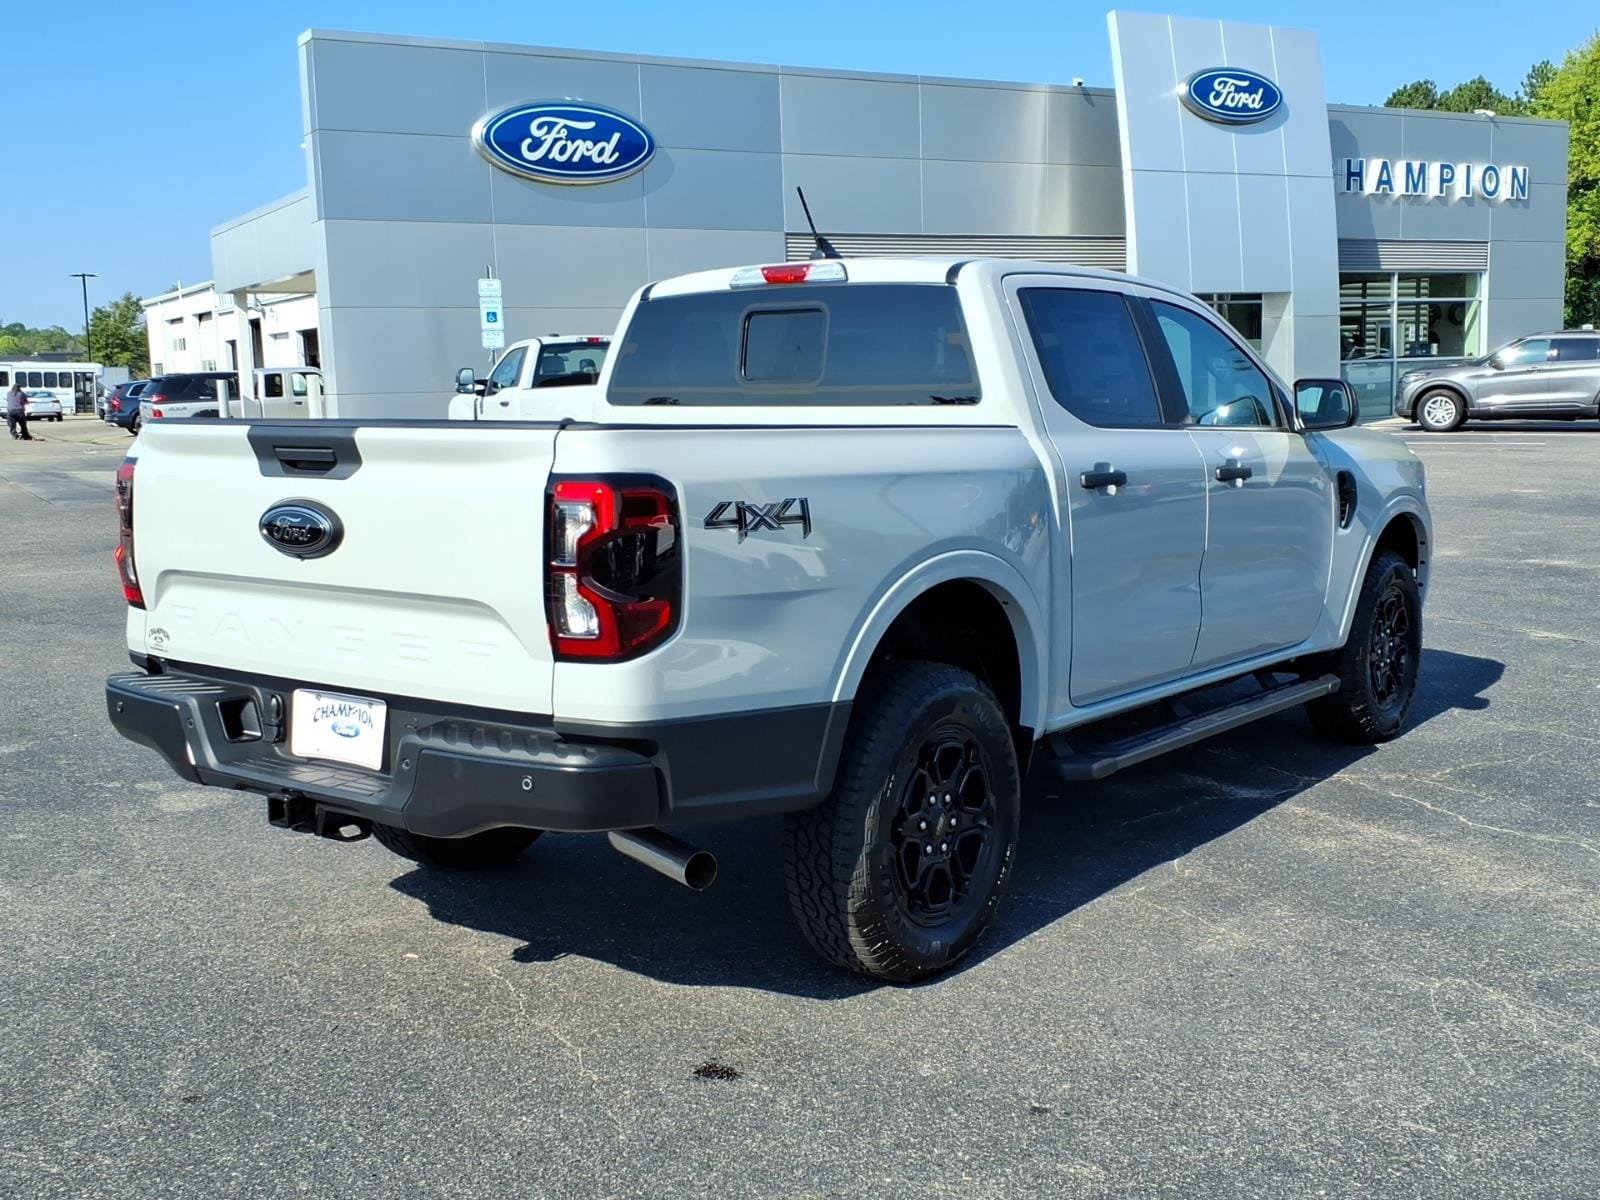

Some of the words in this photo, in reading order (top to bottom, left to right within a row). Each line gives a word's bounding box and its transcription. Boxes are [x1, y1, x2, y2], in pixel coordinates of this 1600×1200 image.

[1209, 77, 1263, 109] Ford
[521, 117, 621, 164] Ford
[1344, 158, 1529, 199] HAMPION
[273, 515, 311, 541] Ford
